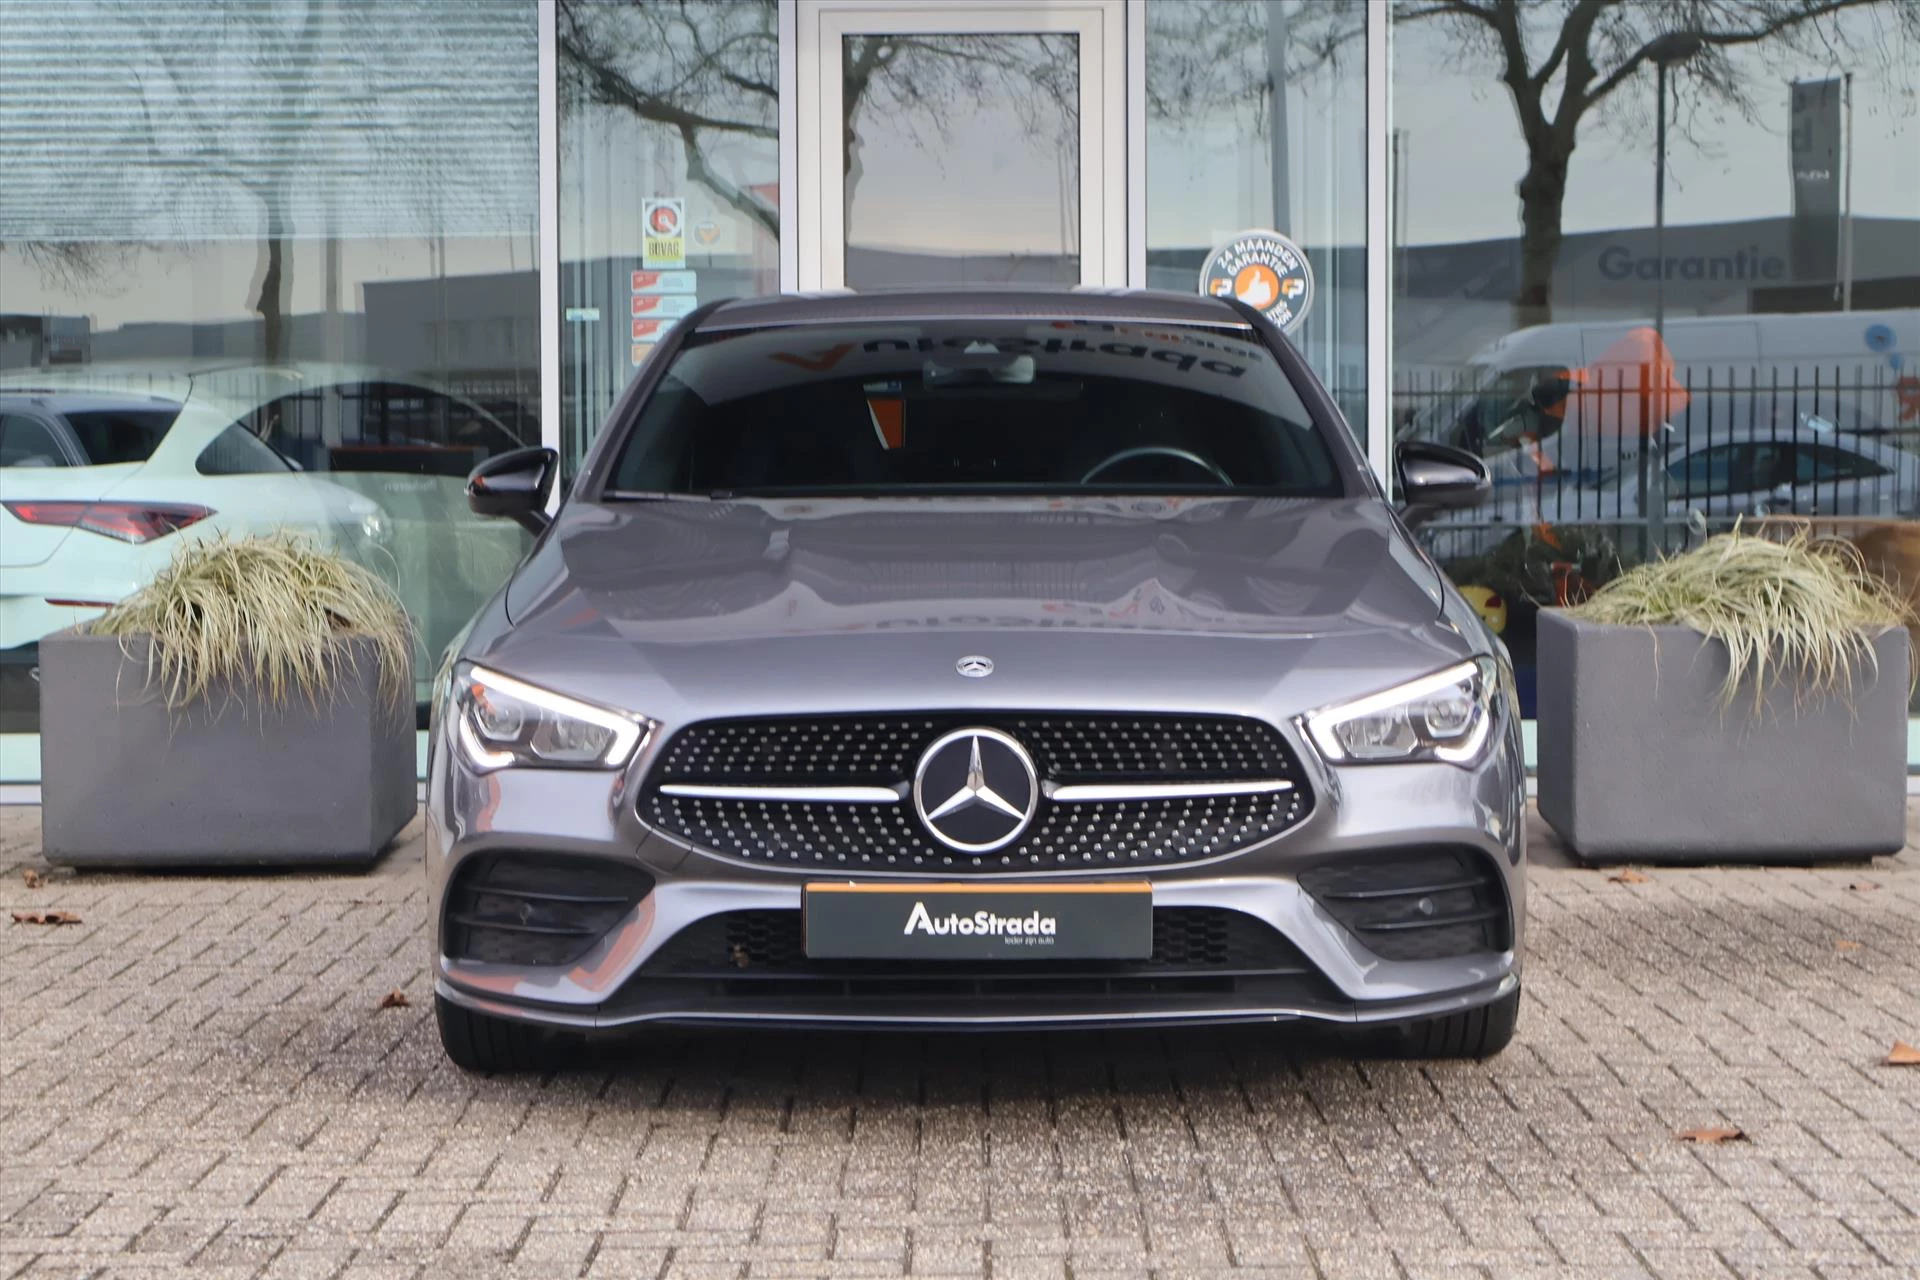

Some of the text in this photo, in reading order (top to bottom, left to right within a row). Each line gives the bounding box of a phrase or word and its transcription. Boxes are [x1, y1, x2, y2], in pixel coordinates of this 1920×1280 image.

[649, 241, 679, 257] BOVAG
[1227, 252, 1288, 278] GARANTIE
[1234, 237, 1299, 271] MAANDEN
[1597, 245, 1786, 282] Garantie
[903, 901, 1056, 935] AutoStrada
